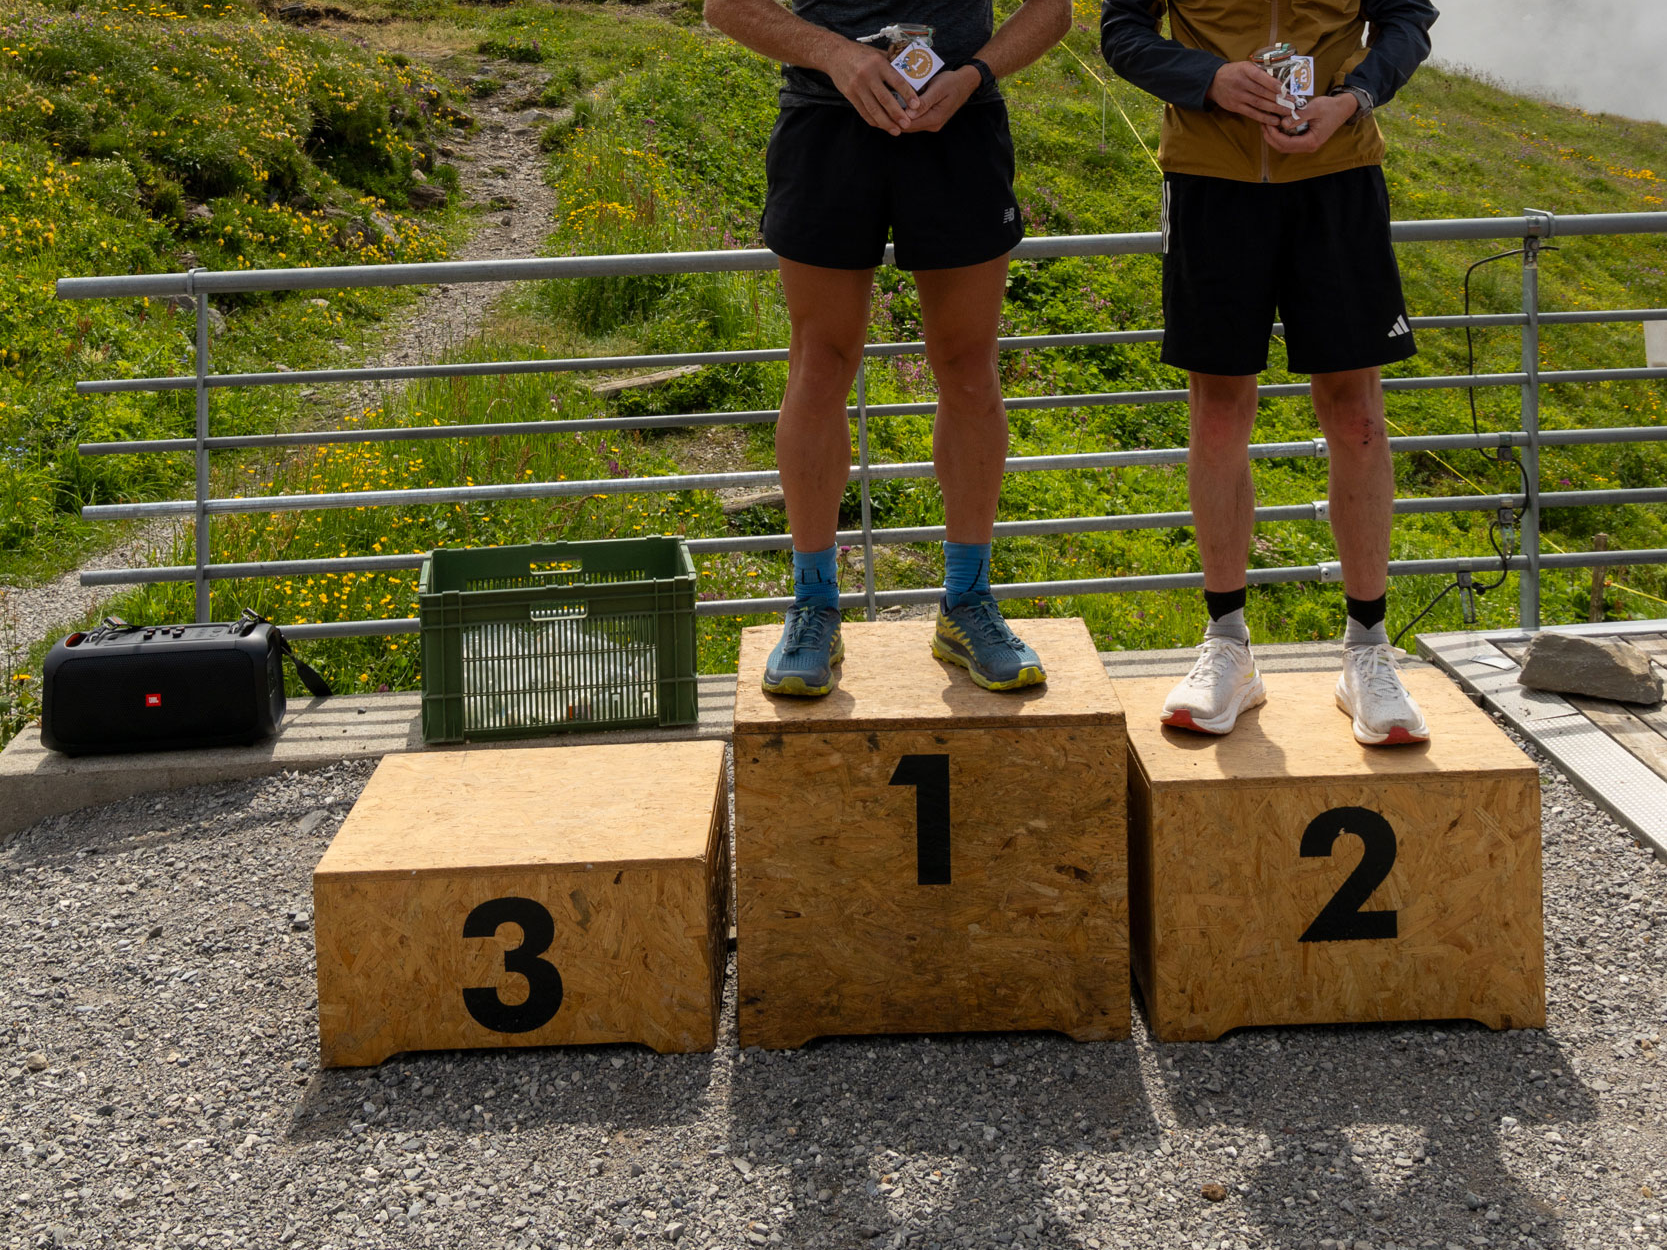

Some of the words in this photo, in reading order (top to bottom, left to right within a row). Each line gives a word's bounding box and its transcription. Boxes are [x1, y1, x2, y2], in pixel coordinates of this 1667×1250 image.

[1300, 68, 1308, 83] 2
[888, 753, 952, 886] 1
[1298, 805, 1398, 944] 2
[462, 896, 564, 1035] 3
